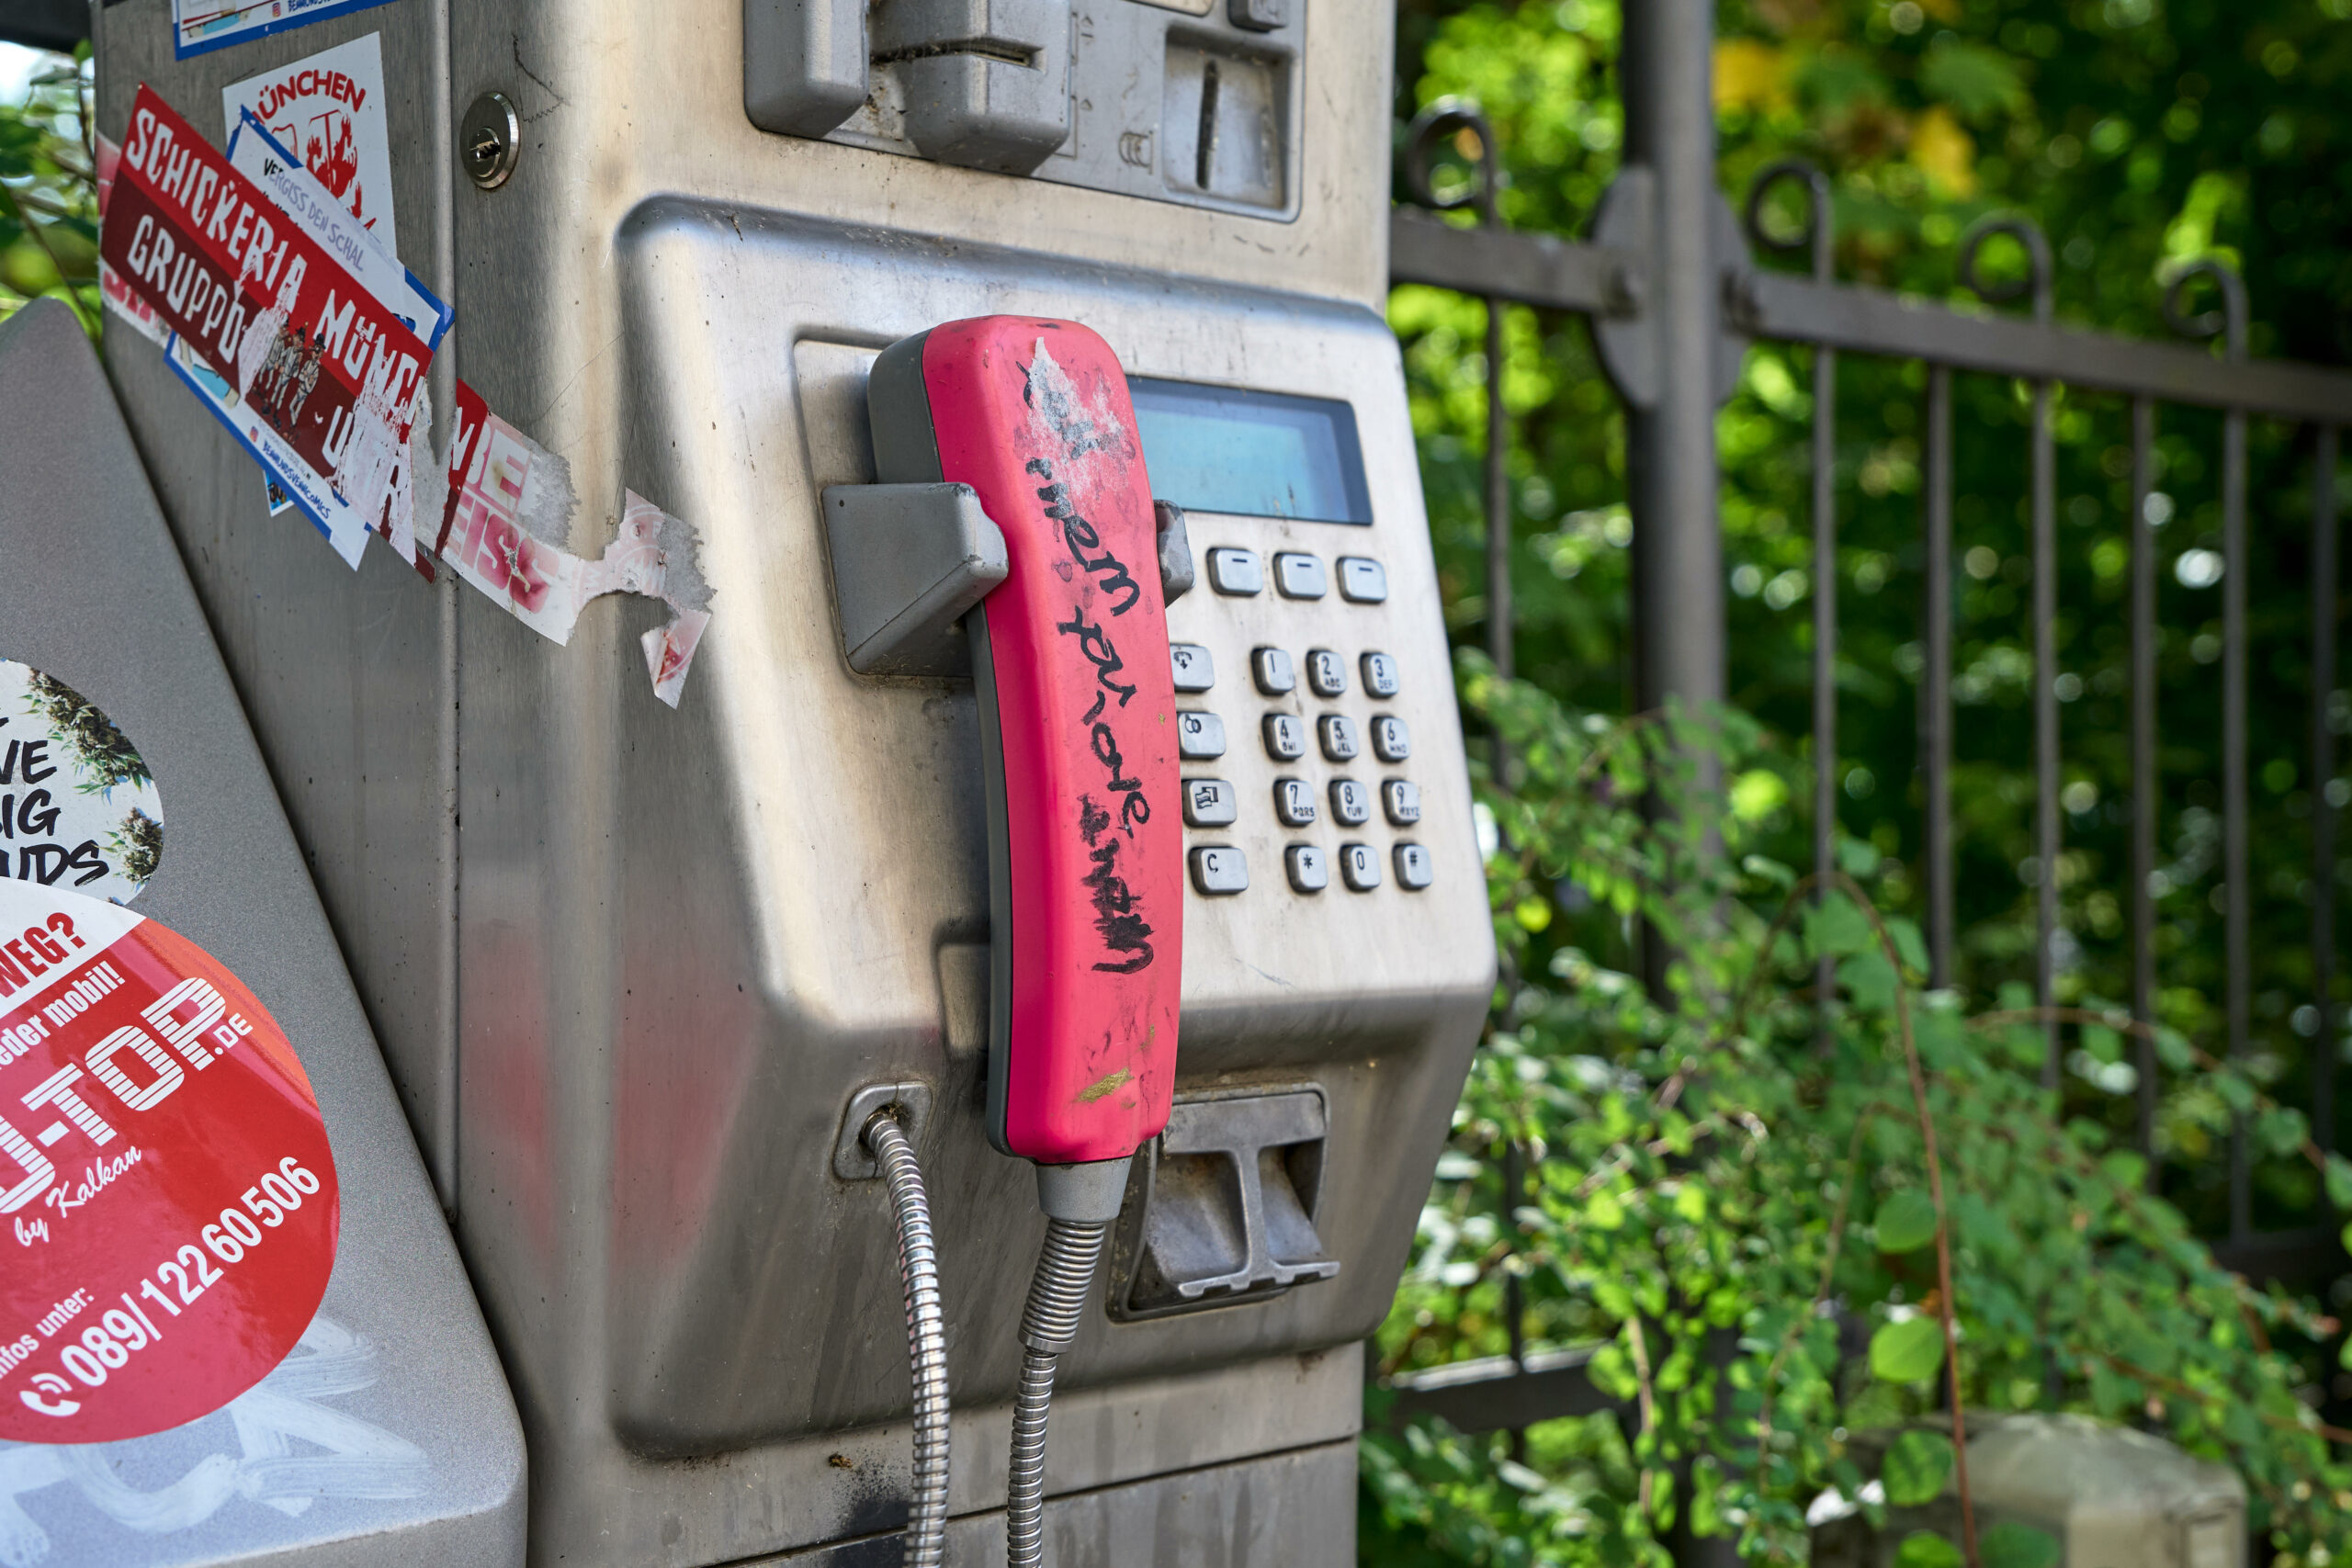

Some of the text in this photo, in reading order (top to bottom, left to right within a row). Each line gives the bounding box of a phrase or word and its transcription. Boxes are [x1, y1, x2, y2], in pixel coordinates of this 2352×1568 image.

[126, 107, 308, 314] SCHICKERIA
[307, 201, 330, 232] DEN
[327, 222, 364, 273] SCHAL
[127, 214, 247, 365] GRUPPO
[1269, 651, 1277, 674] 1
[1321, 654, 1332, 676] 2
[1374, 658, 1385, 678] 3
[1324, 677, 1341, 688] ABC
[1378, 678, 1394, 690] DEF
[1281, 718, 1290, 739] 4
[1333, 719, 1345, 740] 5
[1387, 721, 1396, 742] 6
[1289, 784, 1299, 806] 7
[1343, 784, 1354, 806] 8
[1396, 784, 1406, 806] 9
[1293, 807, 1316, 818] PQRS
[42, 960, 127, 1029] mobil!
[14, 1145, 142, 1247] by Kalkan
[35, 1287, 95, 1337] unter:
